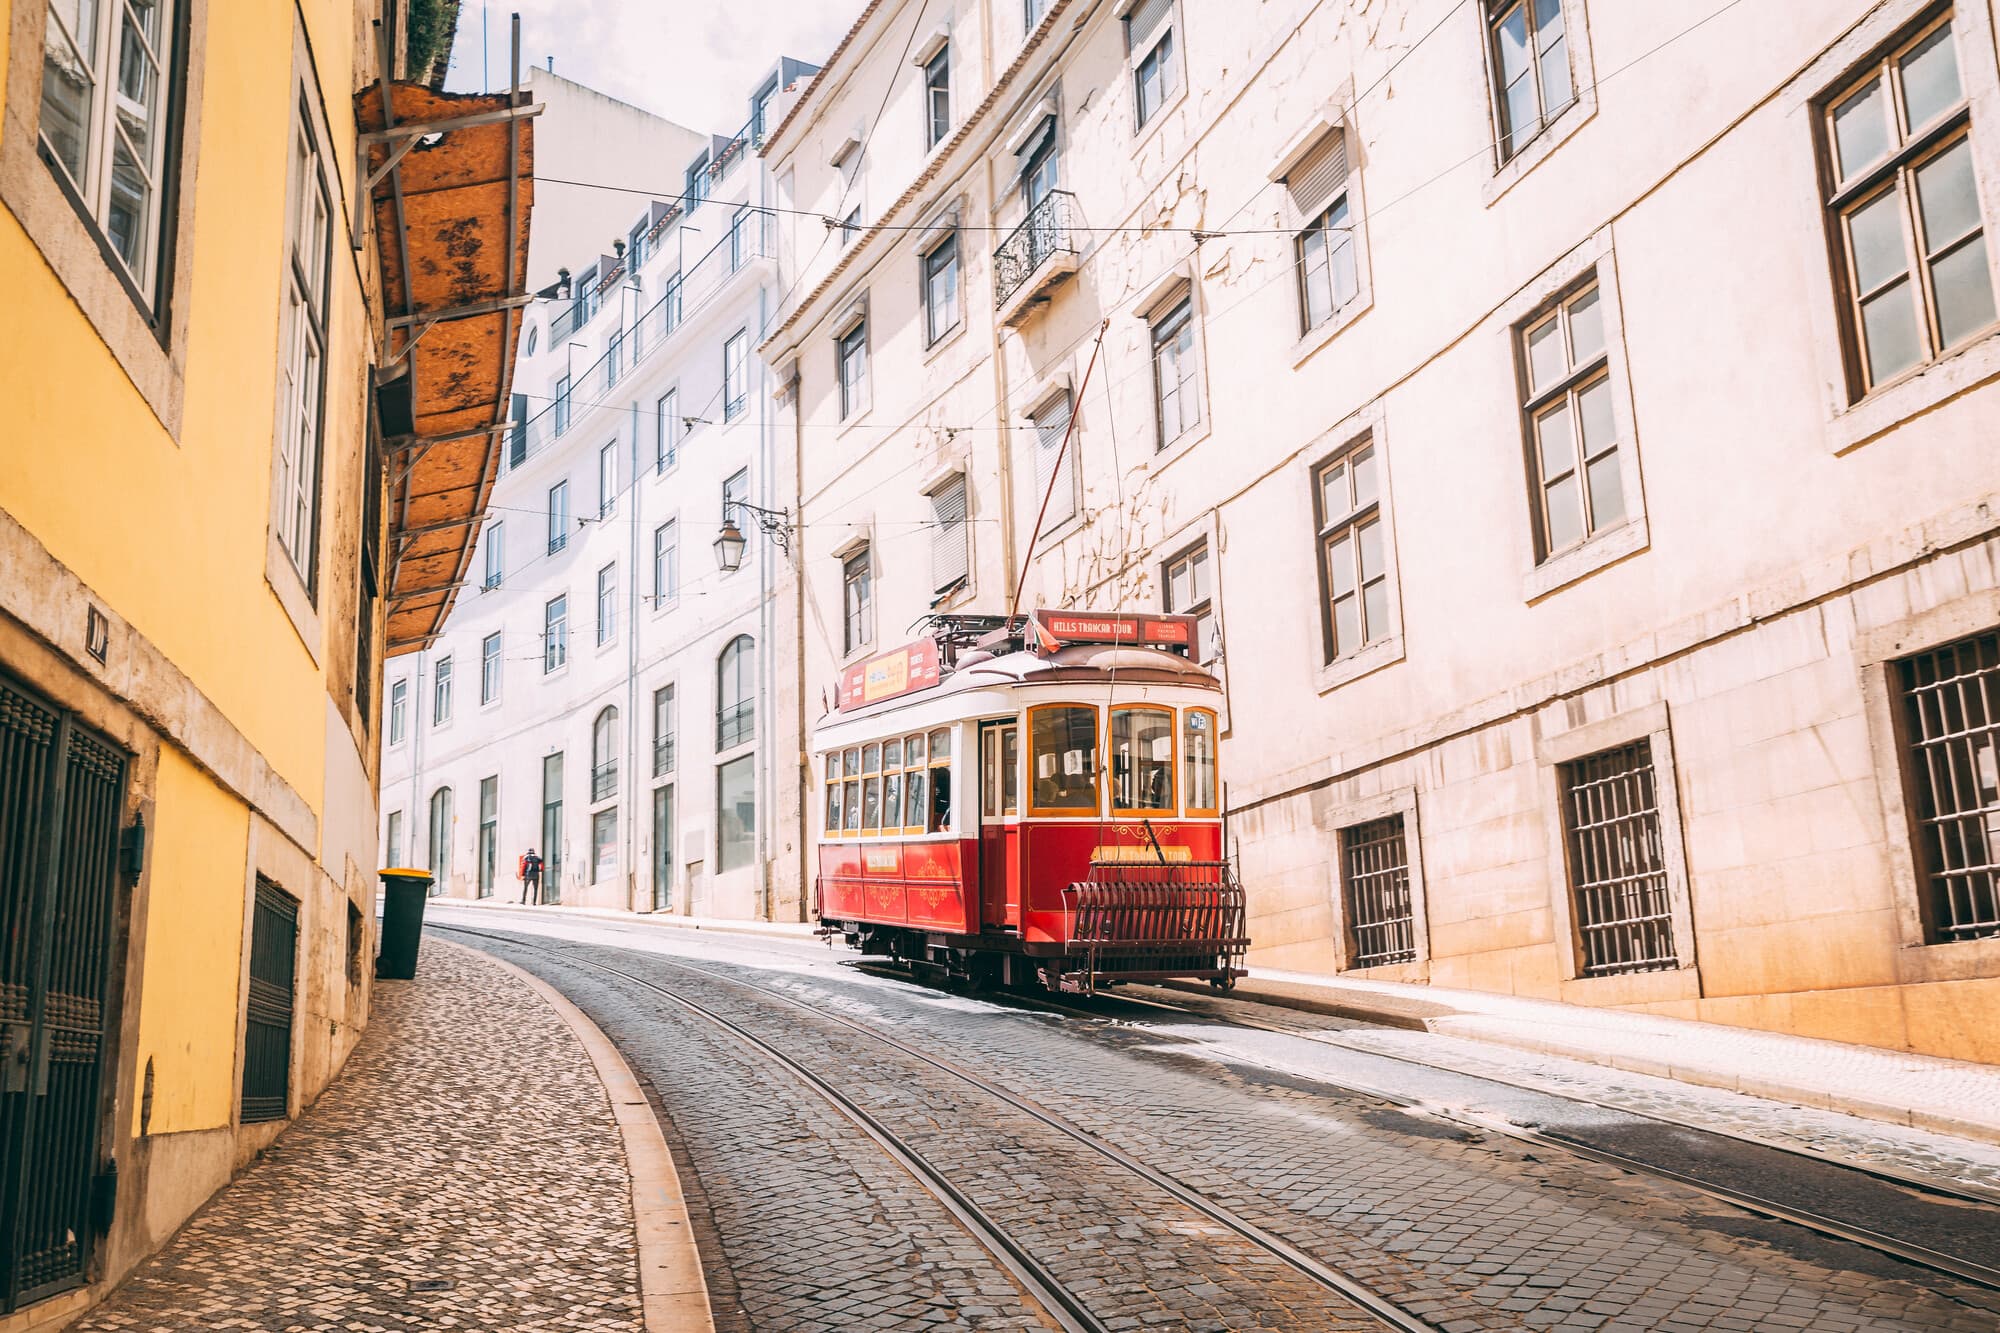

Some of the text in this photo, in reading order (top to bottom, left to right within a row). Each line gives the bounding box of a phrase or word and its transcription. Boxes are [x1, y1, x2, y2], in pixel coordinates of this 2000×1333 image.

[1053, 621, 1133, 635] HILLS TRAMCAR TOUR
[1142, 687, 1148, 699] 7
